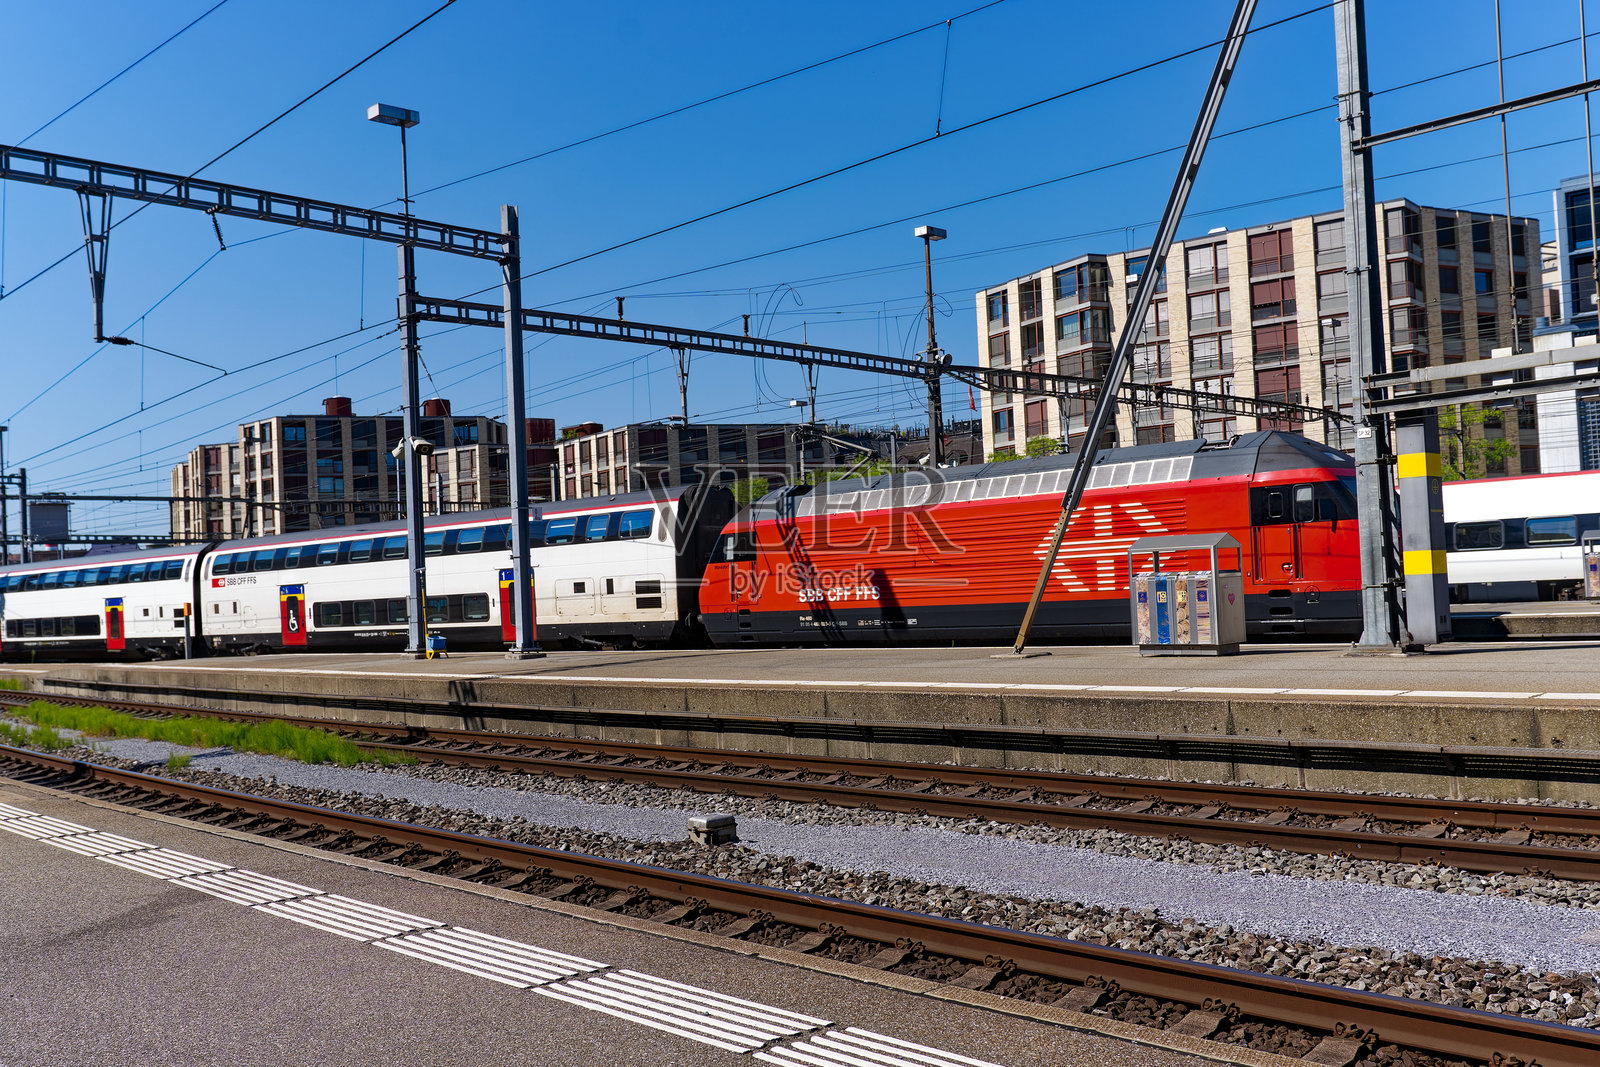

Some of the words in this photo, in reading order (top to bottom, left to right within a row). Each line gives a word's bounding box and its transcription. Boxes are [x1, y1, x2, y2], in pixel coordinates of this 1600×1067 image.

[227, 578, 236, 586] SBB
[237, 577, 247, 585] CFF
[247, 576, 257, 584] FFS
[799, 588, 824, 602] SBB
[827, 587, 851, 601] CFF
[856, 586, 880, 600] FFS
